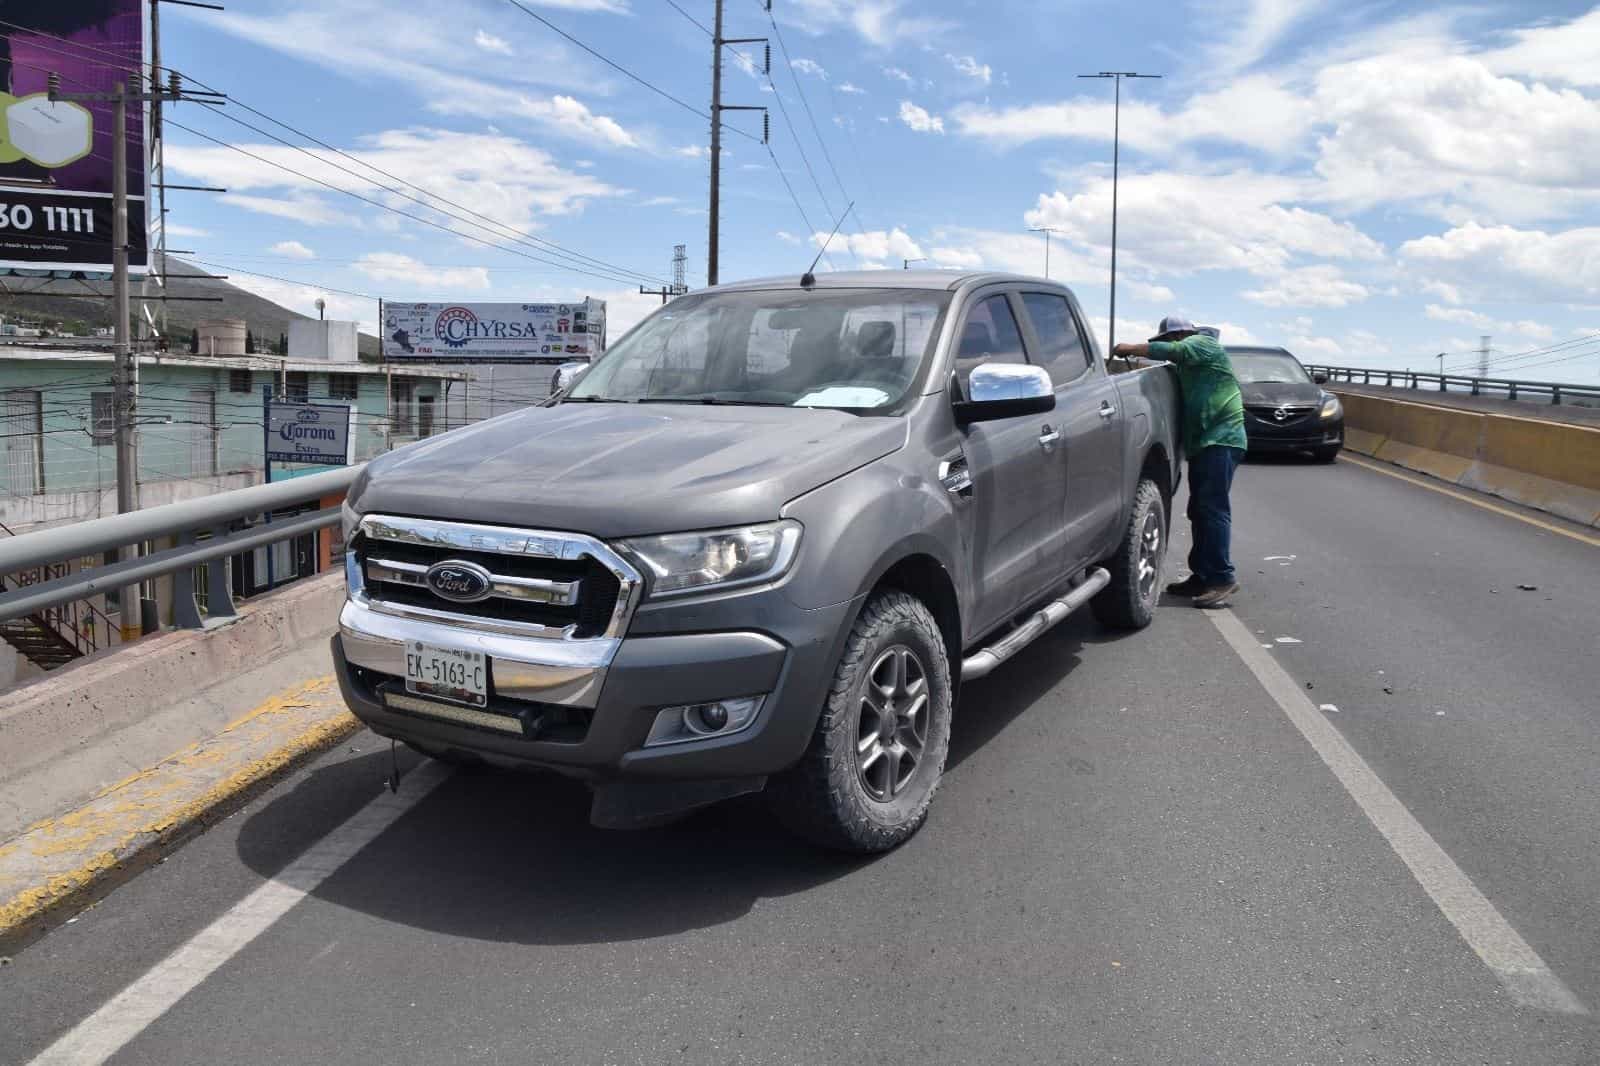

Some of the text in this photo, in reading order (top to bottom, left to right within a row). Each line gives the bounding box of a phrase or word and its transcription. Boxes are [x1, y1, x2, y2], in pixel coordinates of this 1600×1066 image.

[42, 206, 94, 233] 1111
[447, 318, 538, 340] CHYRSA
[280, 422, 336, 442] Corona
[295, 443, 320, 453] Extra
[436, 570, 471, 592] Ford
[407, 654, 482, 690] EK-5163-C
